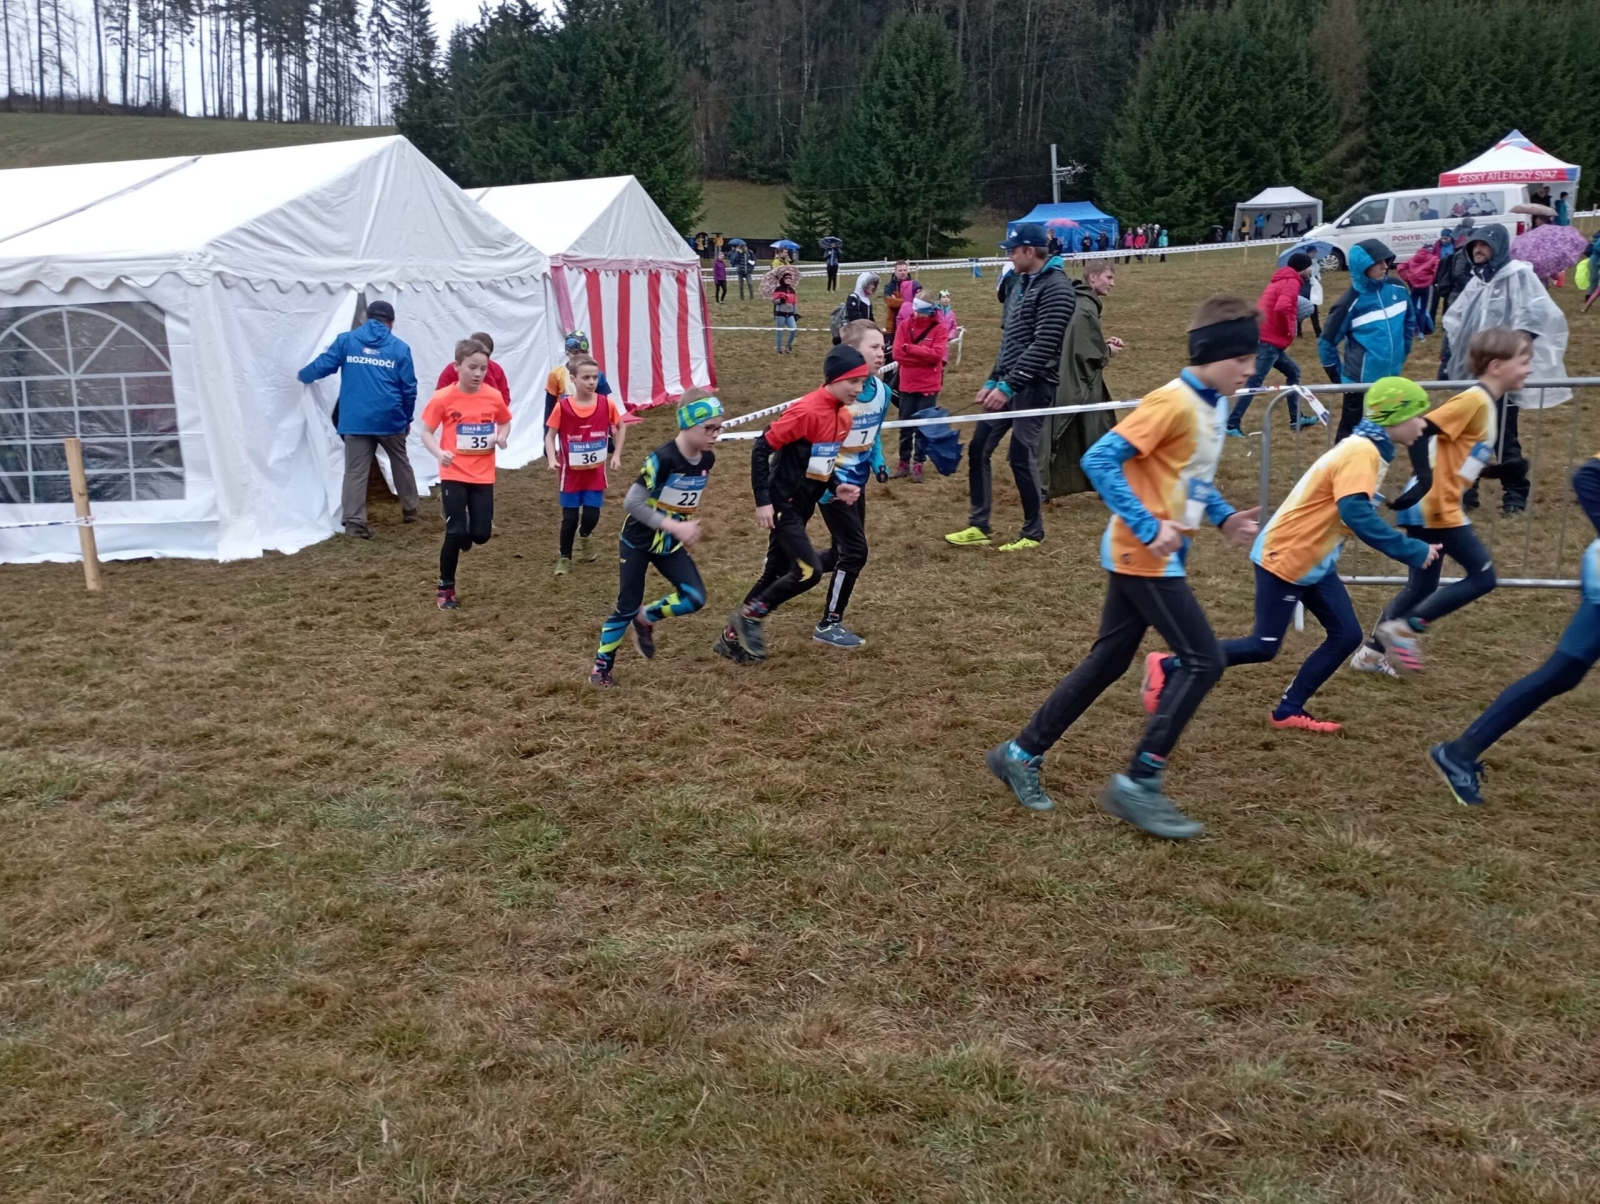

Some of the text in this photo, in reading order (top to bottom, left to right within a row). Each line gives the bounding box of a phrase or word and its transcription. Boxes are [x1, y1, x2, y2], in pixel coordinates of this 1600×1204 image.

[1458, 170, 1558, 183] ČESKÝ ATLETICKÝ SVAZ
[346, 355, 395, 369] ROZHODČÍ
[471, 437, 487, 449] 35
[860, 430, 869, 445] 7
[582, 452, 597, 464] 36
[677, 492, 698, 506] 22
